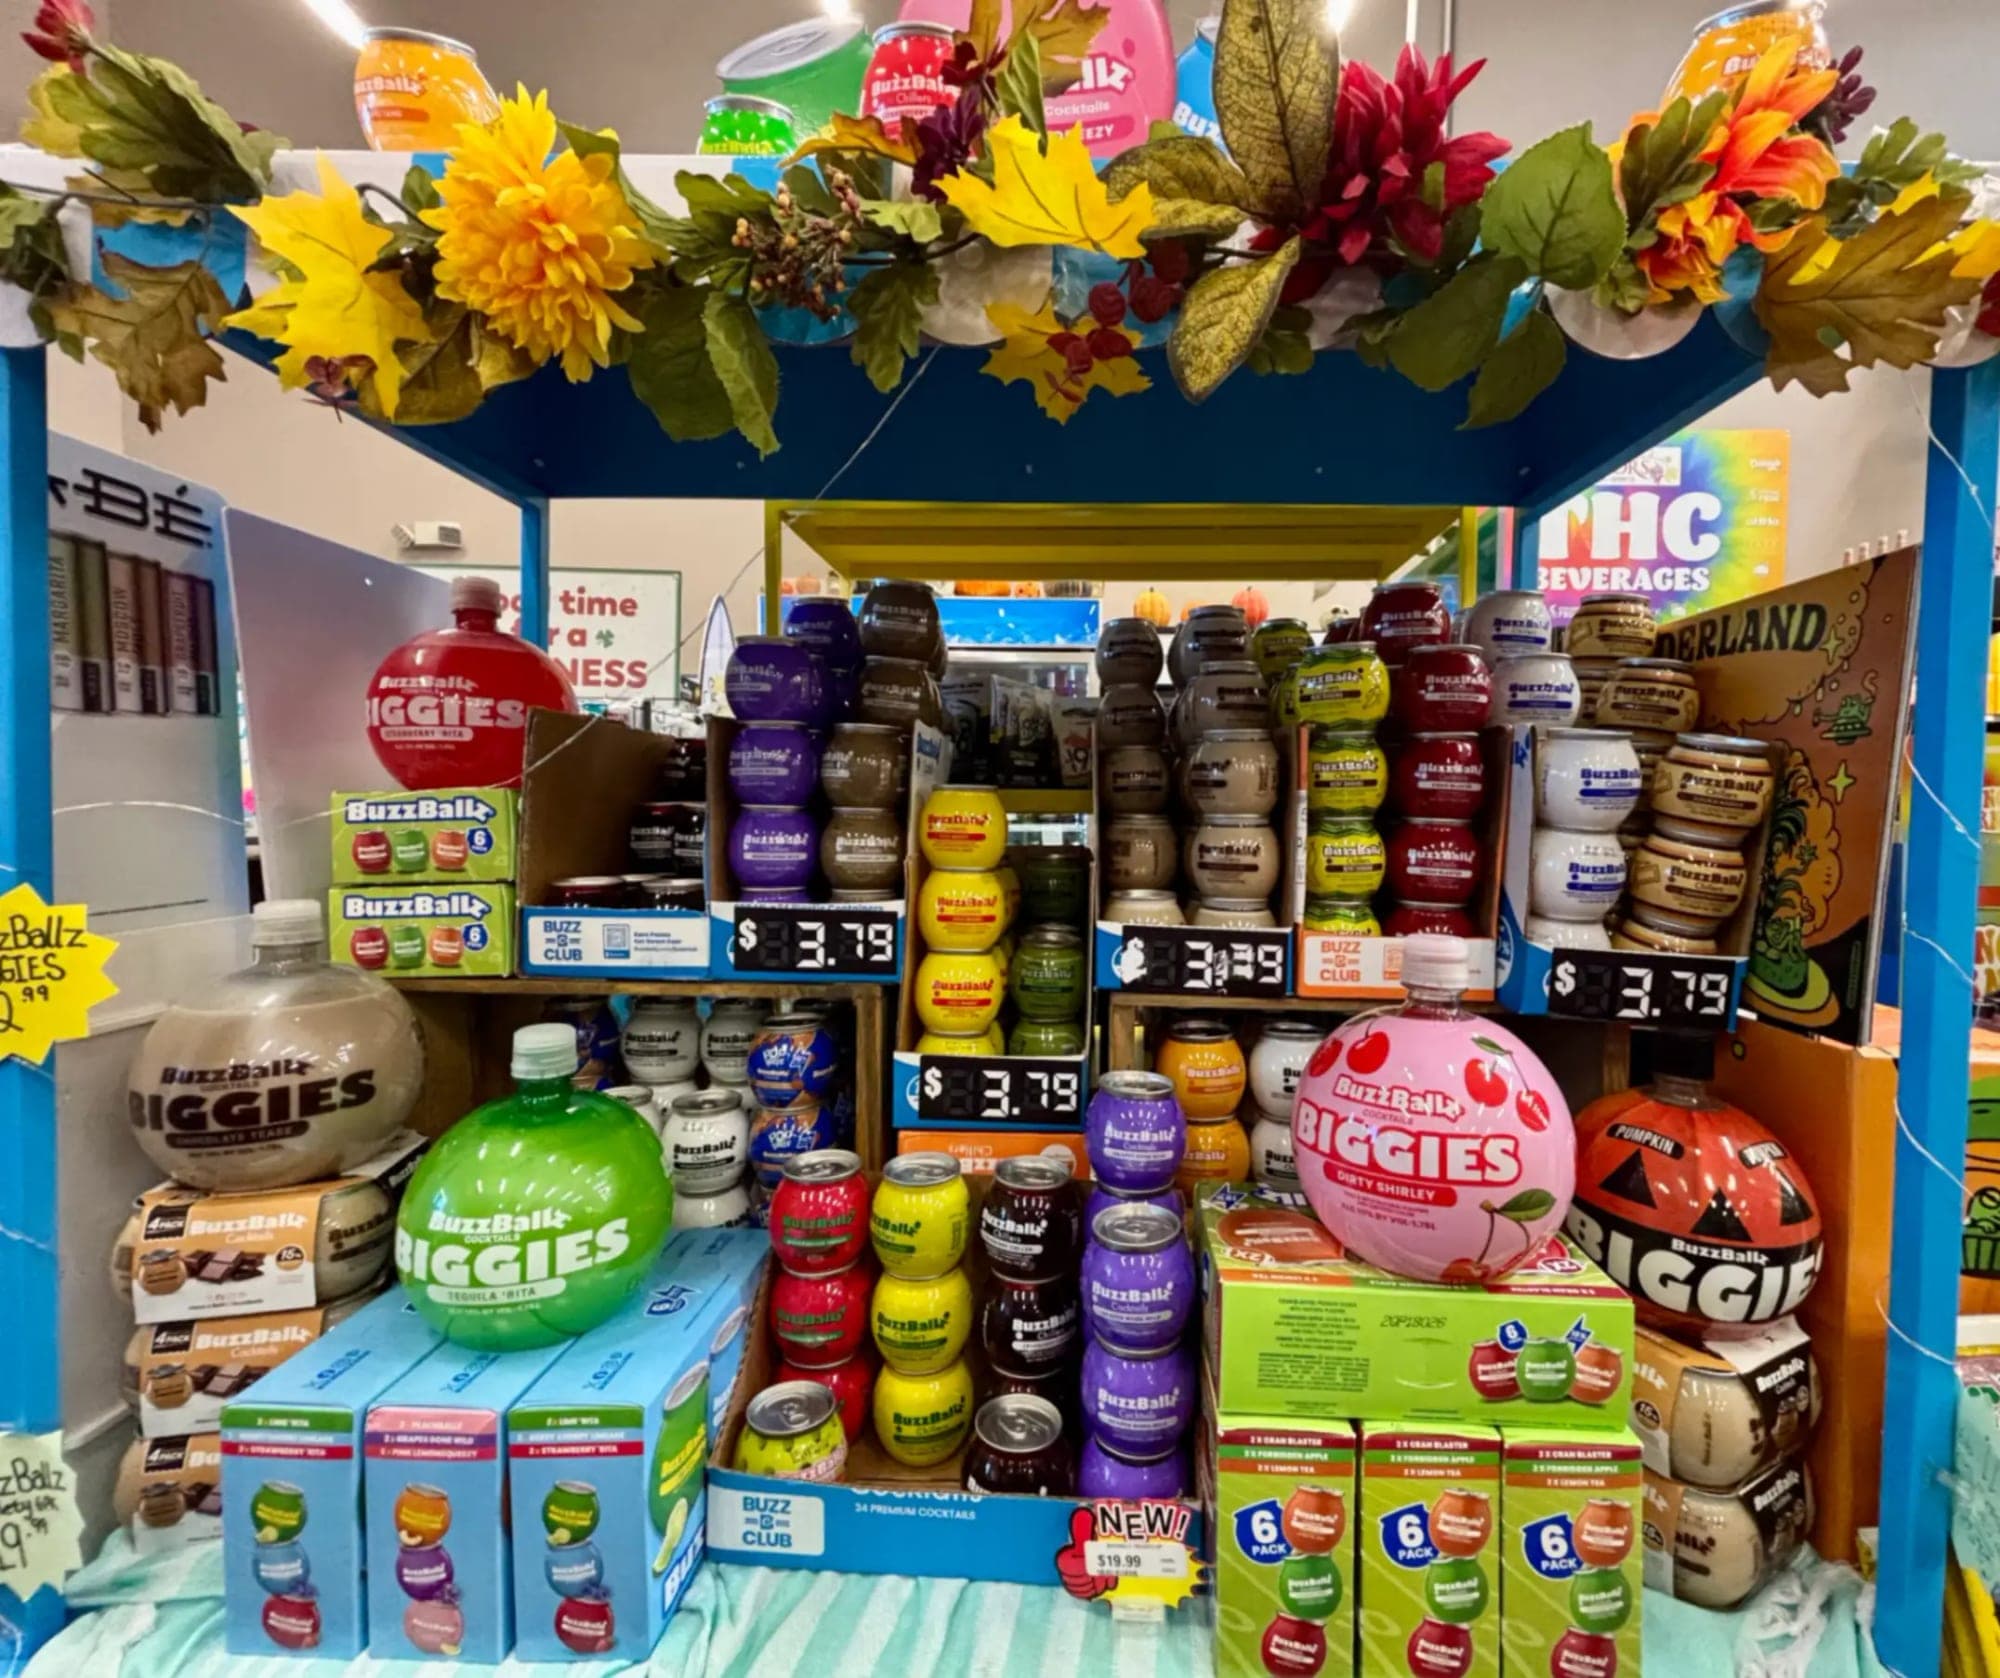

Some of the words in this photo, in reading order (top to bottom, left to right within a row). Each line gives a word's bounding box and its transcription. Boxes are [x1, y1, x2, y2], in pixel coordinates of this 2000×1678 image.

[1539, 490, 1722, 562] THC
[1537, 566, 1710, 592] BEVERAGES
[559, 586, 638, 617] time
[567, 629, 587, 647] a
[379, 676, 478, 692] BuzzBallz
[1508, 682, 1574, 697] BuzzBallz
[1681, 771, 1764, 795] BuzzBallz
[346, 797, 496, 824] BuzzBallz
[472, 828, 487, 847] 6
[1669, 864, 1744, 888] BuzzBallz
[344, 893, 491, 920] BuzzBallz
[469, 926, 484, 945] 6
[543, 920, 581, 933] BUZZ
[543, 949, 583, 961] CLUB
[738, 918, 758, 951] $
[796, 921, 894, 969] 3.79
[1320, 940, 1361, 954] BUZZ
[931, 980, 994, 993] BuzzBallz
[1319, 970, 1361, 982] CLUB
[1554, 960, 1576, 997] $
[1616, 966, 1729, 1019] 3.79
[160, 1058, 316, 1085] BuzzBallz
[128, 1070, 376, 1131] BIGGIES
[923, 1065, 943, 1100] $
[980, 1070, 1078, 1118] 3.79
[1334, 1075, 1466, 1122] BuzzBallz
[1104, 1121, 1177, 1143] BuzzBallz
[1296, 1099, 1522, 1186] BIGGIES
[1614, 1124, 1675, 1155] PUMPKIN
[672, 1135, 736, 1156] BuzzBallz
[1337, 1170, 1375, 1190] DIRTY
[1375, 1182, 1436, 1202] SHIRLEY
[147, 1216, 162, 1231] 4
[188, 1212, 308, 1236] BuzzBallz
[427, 1206, 571, 1235] BuzzBallz
[784, 1211, 856, 1229] BuzzBallz
[982, 1207, 1049, 1238] BuzzBallz
[394, 1217, 631, 1285] BIGGIES
[1670, 1238, 1770, 1267] BuzzBallz
[447, 1290, 497, 1302] TEQUILA
[1092, 1280, 1175, 1304] BuzzBallz
[777, 1308, 847, 1326] BuzzBallz
[877, 1311, 951, 1333] BuzzBallz
[154, 1330, 168, 1345] 4
[194, 1325, 313, 1350] BuzzBallz
[1505, 1324, 1519, 1340] 6
[1754, 1356, 1807, 1394] BuzzBallz
[1097, 1385, 1180, 1412] BuzzBallz
[893, 1396, 966, 1427] BuzzBallz
[541, 1445, 596, 1454] STRAWBERRY
[1287, 1437, 1323, 1446] BLASTER
[147, 1449, 162, 1463] 4
[1753, 1470, 1801, 1513] BuzzBallz
[742, 1496, 792, 1512] BUZZ
[869, 1504, 917, 1516] PREMIUM
[917, 1507, 977, 1521] COCKTAILS
[1099, 1502, 1188, 1541] NEW!
[1250, 1509, 1278, 1544] 6
[1396, 1514, 1425, 1549] 6
[742, 1531, 792, 1548] CLUB
[1252, 1543, 1287, 1556] PACK
[1540, 1523, 1569, 1560] 6
[1097, 1554, 1142, 1568] $19.99
[1398, 1547, 1433, 1560] PACK
[1541, 1558, 1577, 1572] PACK
